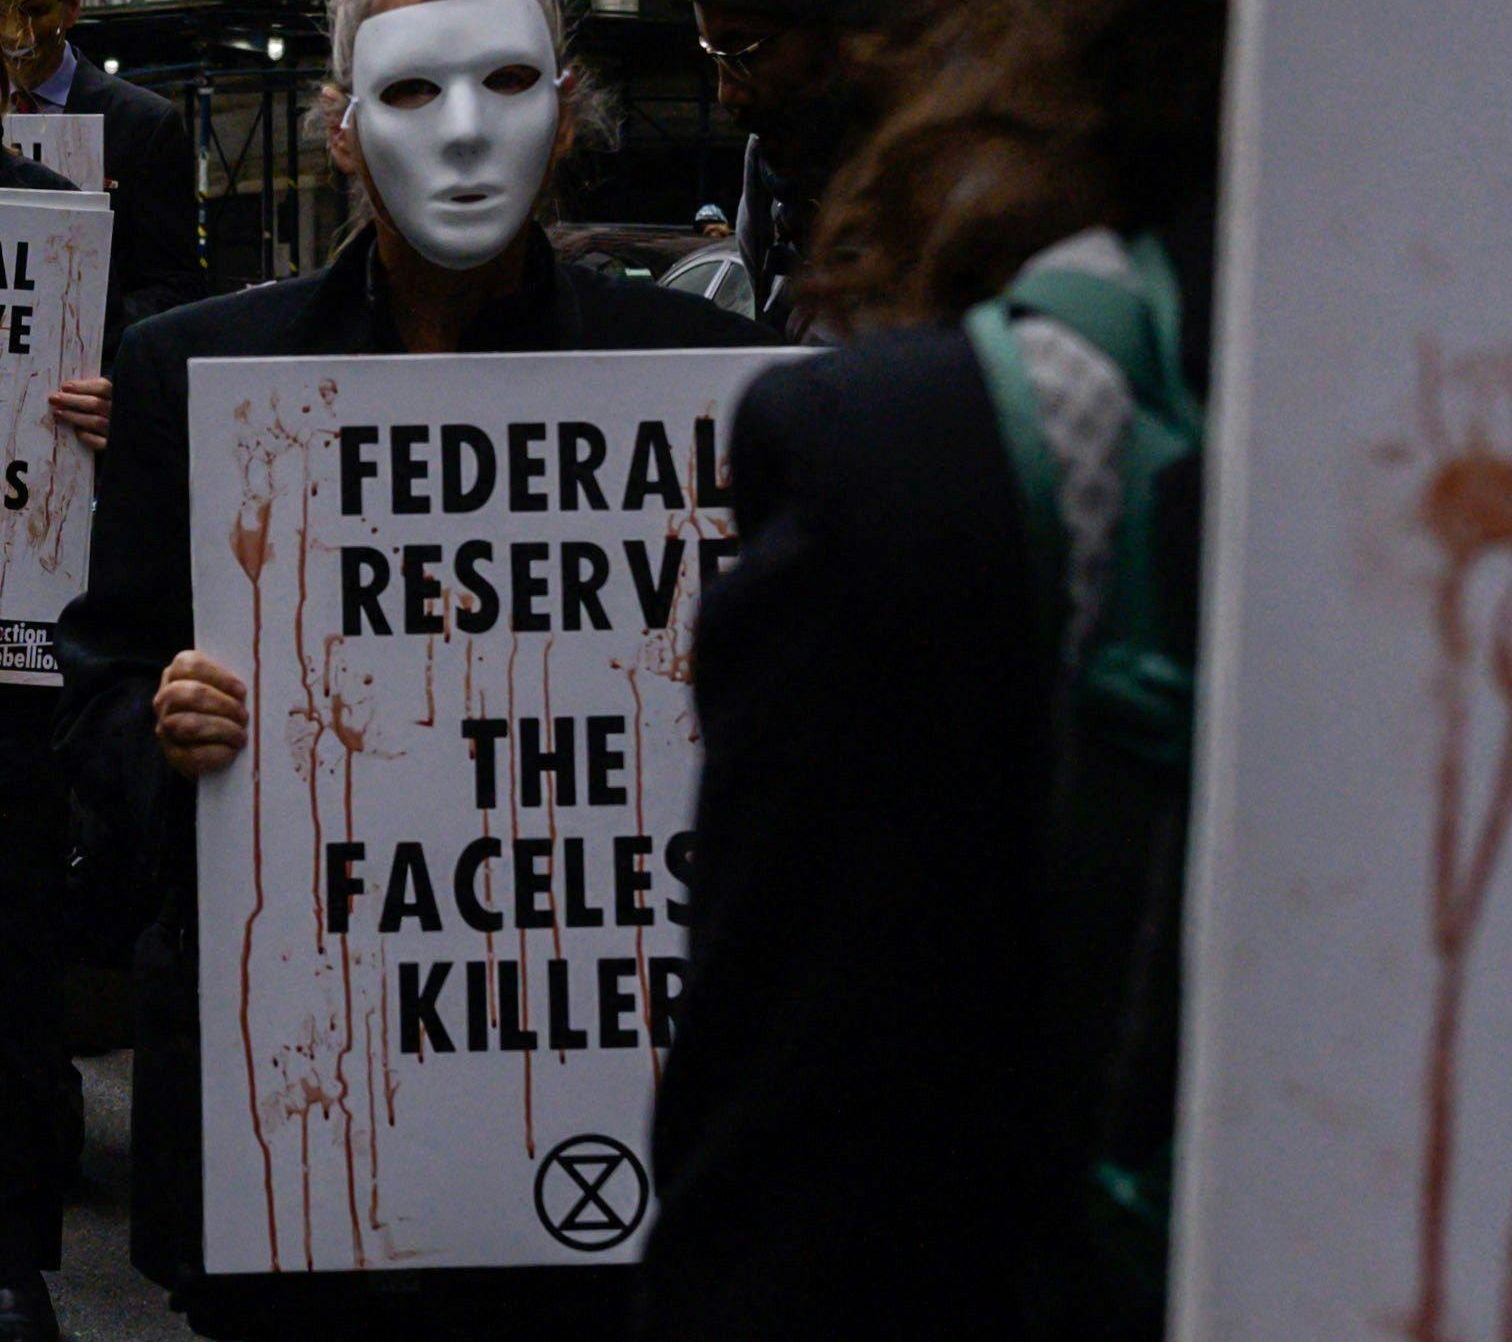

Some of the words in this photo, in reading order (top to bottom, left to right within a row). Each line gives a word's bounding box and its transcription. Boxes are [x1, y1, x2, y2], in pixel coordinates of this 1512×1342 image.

[336, 419, 736, 515] FEDERAL
[462, 716, 627, 809] THE
[326, 831, 700, 934] FACELES
[399, 958, 689, 1055] KILLER
